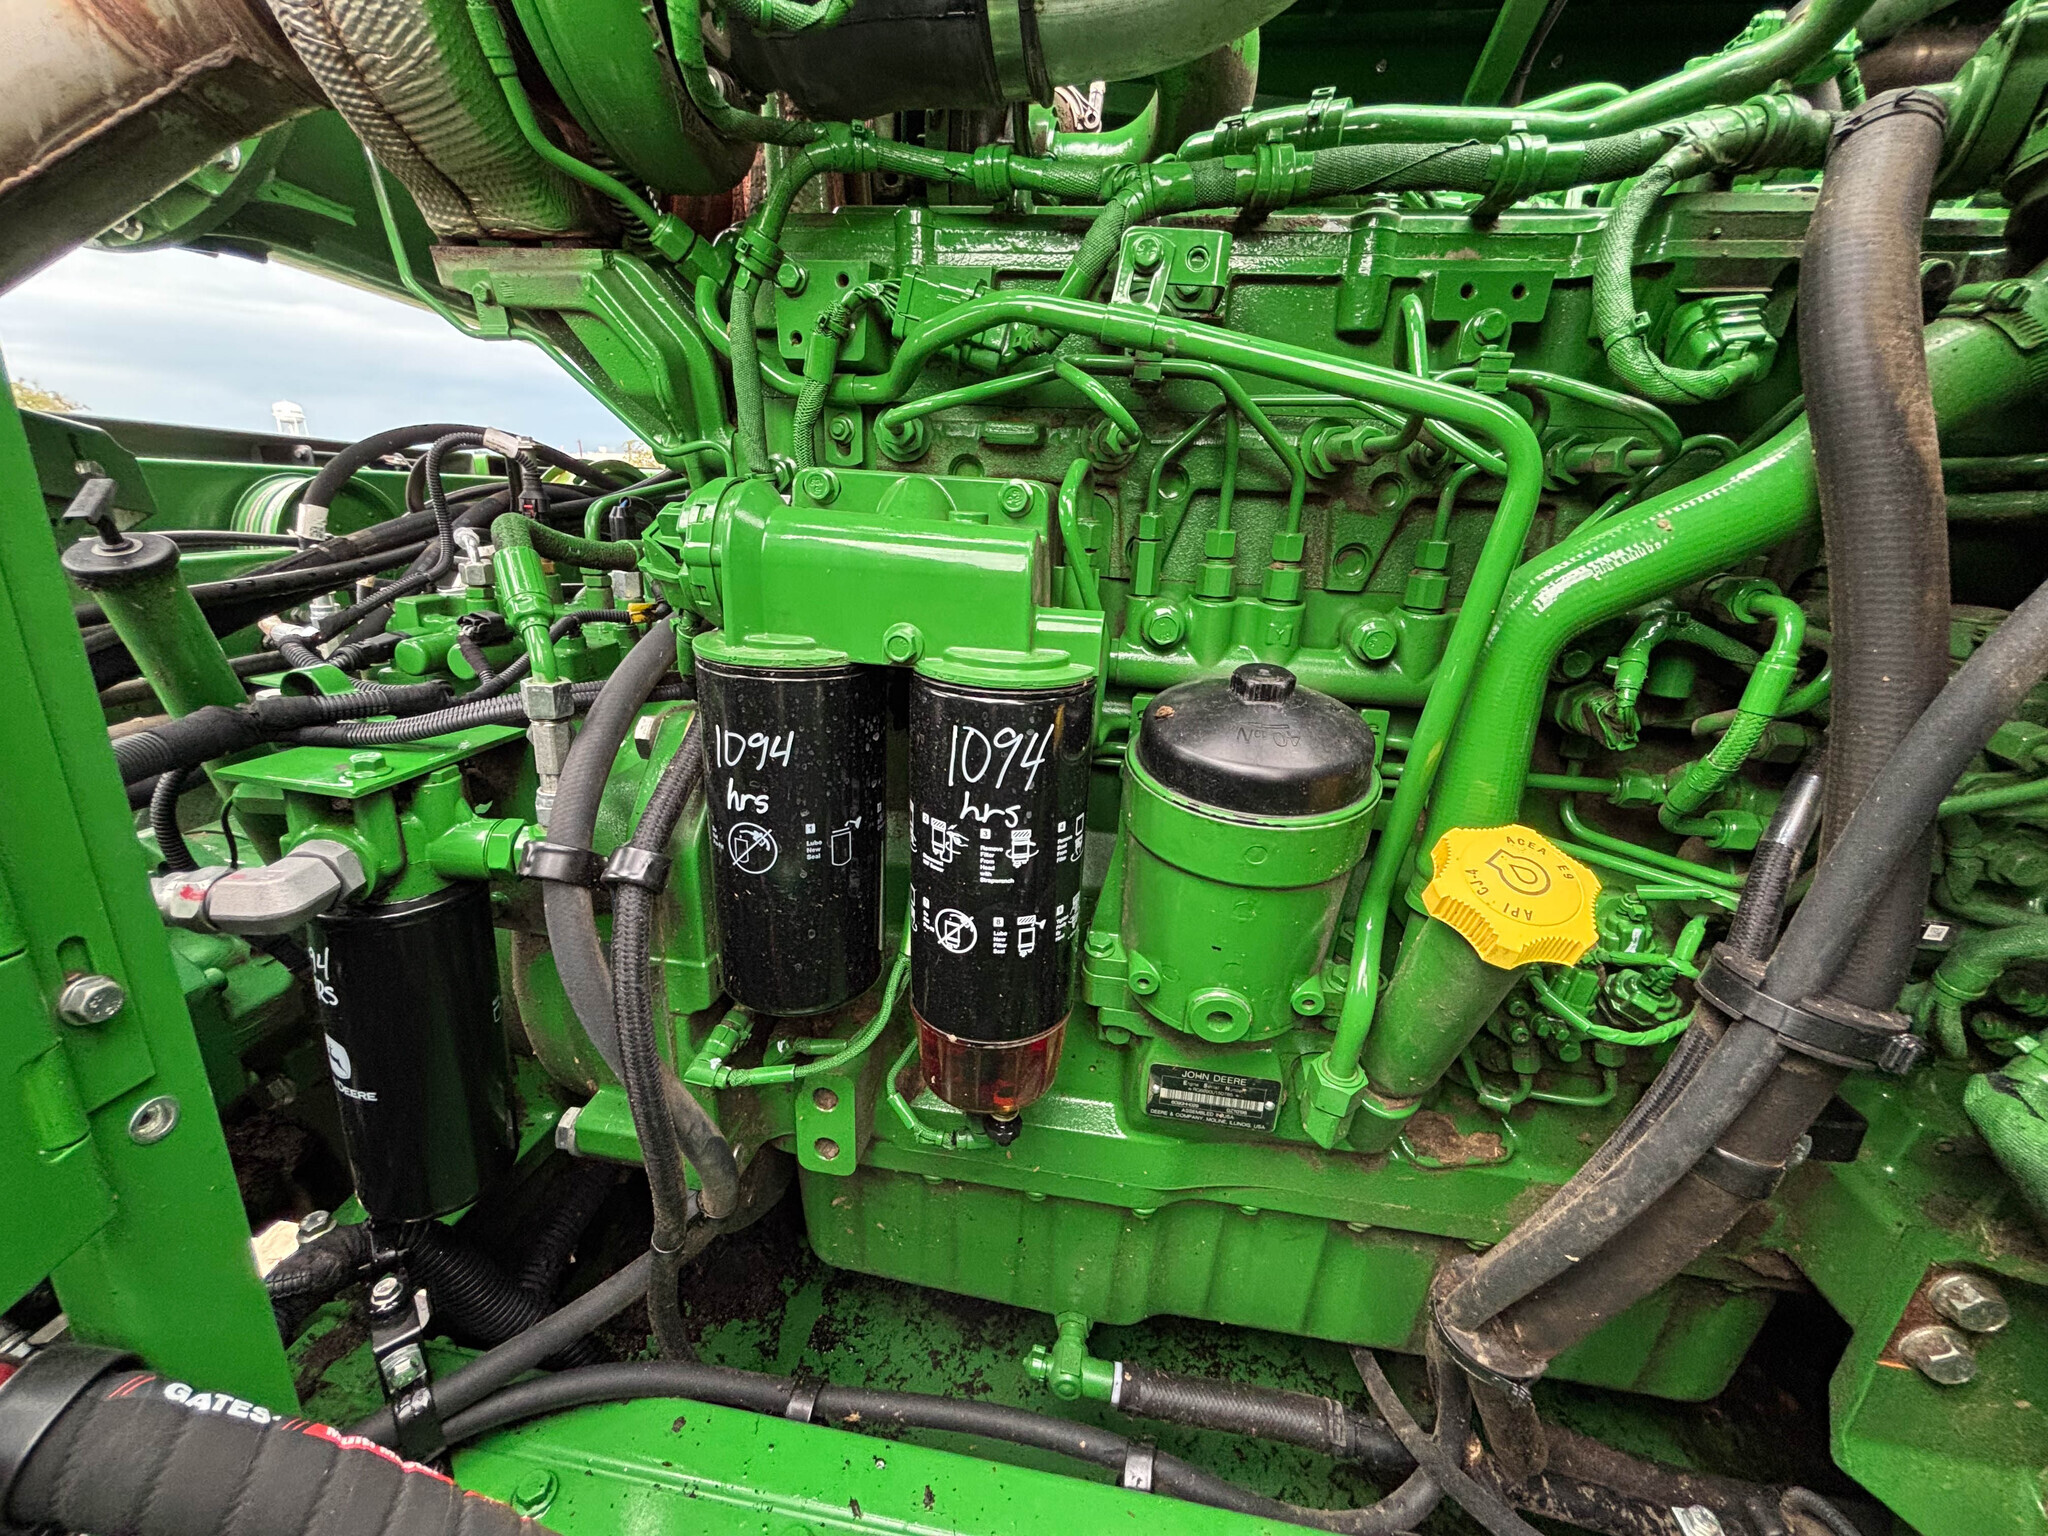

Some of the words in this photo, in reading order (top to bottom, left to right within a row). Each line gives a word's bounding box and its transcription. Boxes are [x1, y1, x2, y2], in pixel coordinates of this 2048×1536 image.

[715, 724, 795, 771] 1094
[947, 723, 1055, 791] 1094
[727, 777, 770, 815] hrs
[960, 791, 1021, 828] hrs
[1506, 836, 1547, 856] ACEA
[1465, 868, 1489, 896] CJ-4
[1503, 902, 1533, 921] API
[1181, 1070, 1210, 1081] JOHN
[1212, 1074, 1248, 1086] DEERE
[1150, 1108, 1168, 1116] DEERE
[1181, 1107, 1214, 1117] ASSEMBLED
[163, 1382, 273, 1424] GATES
